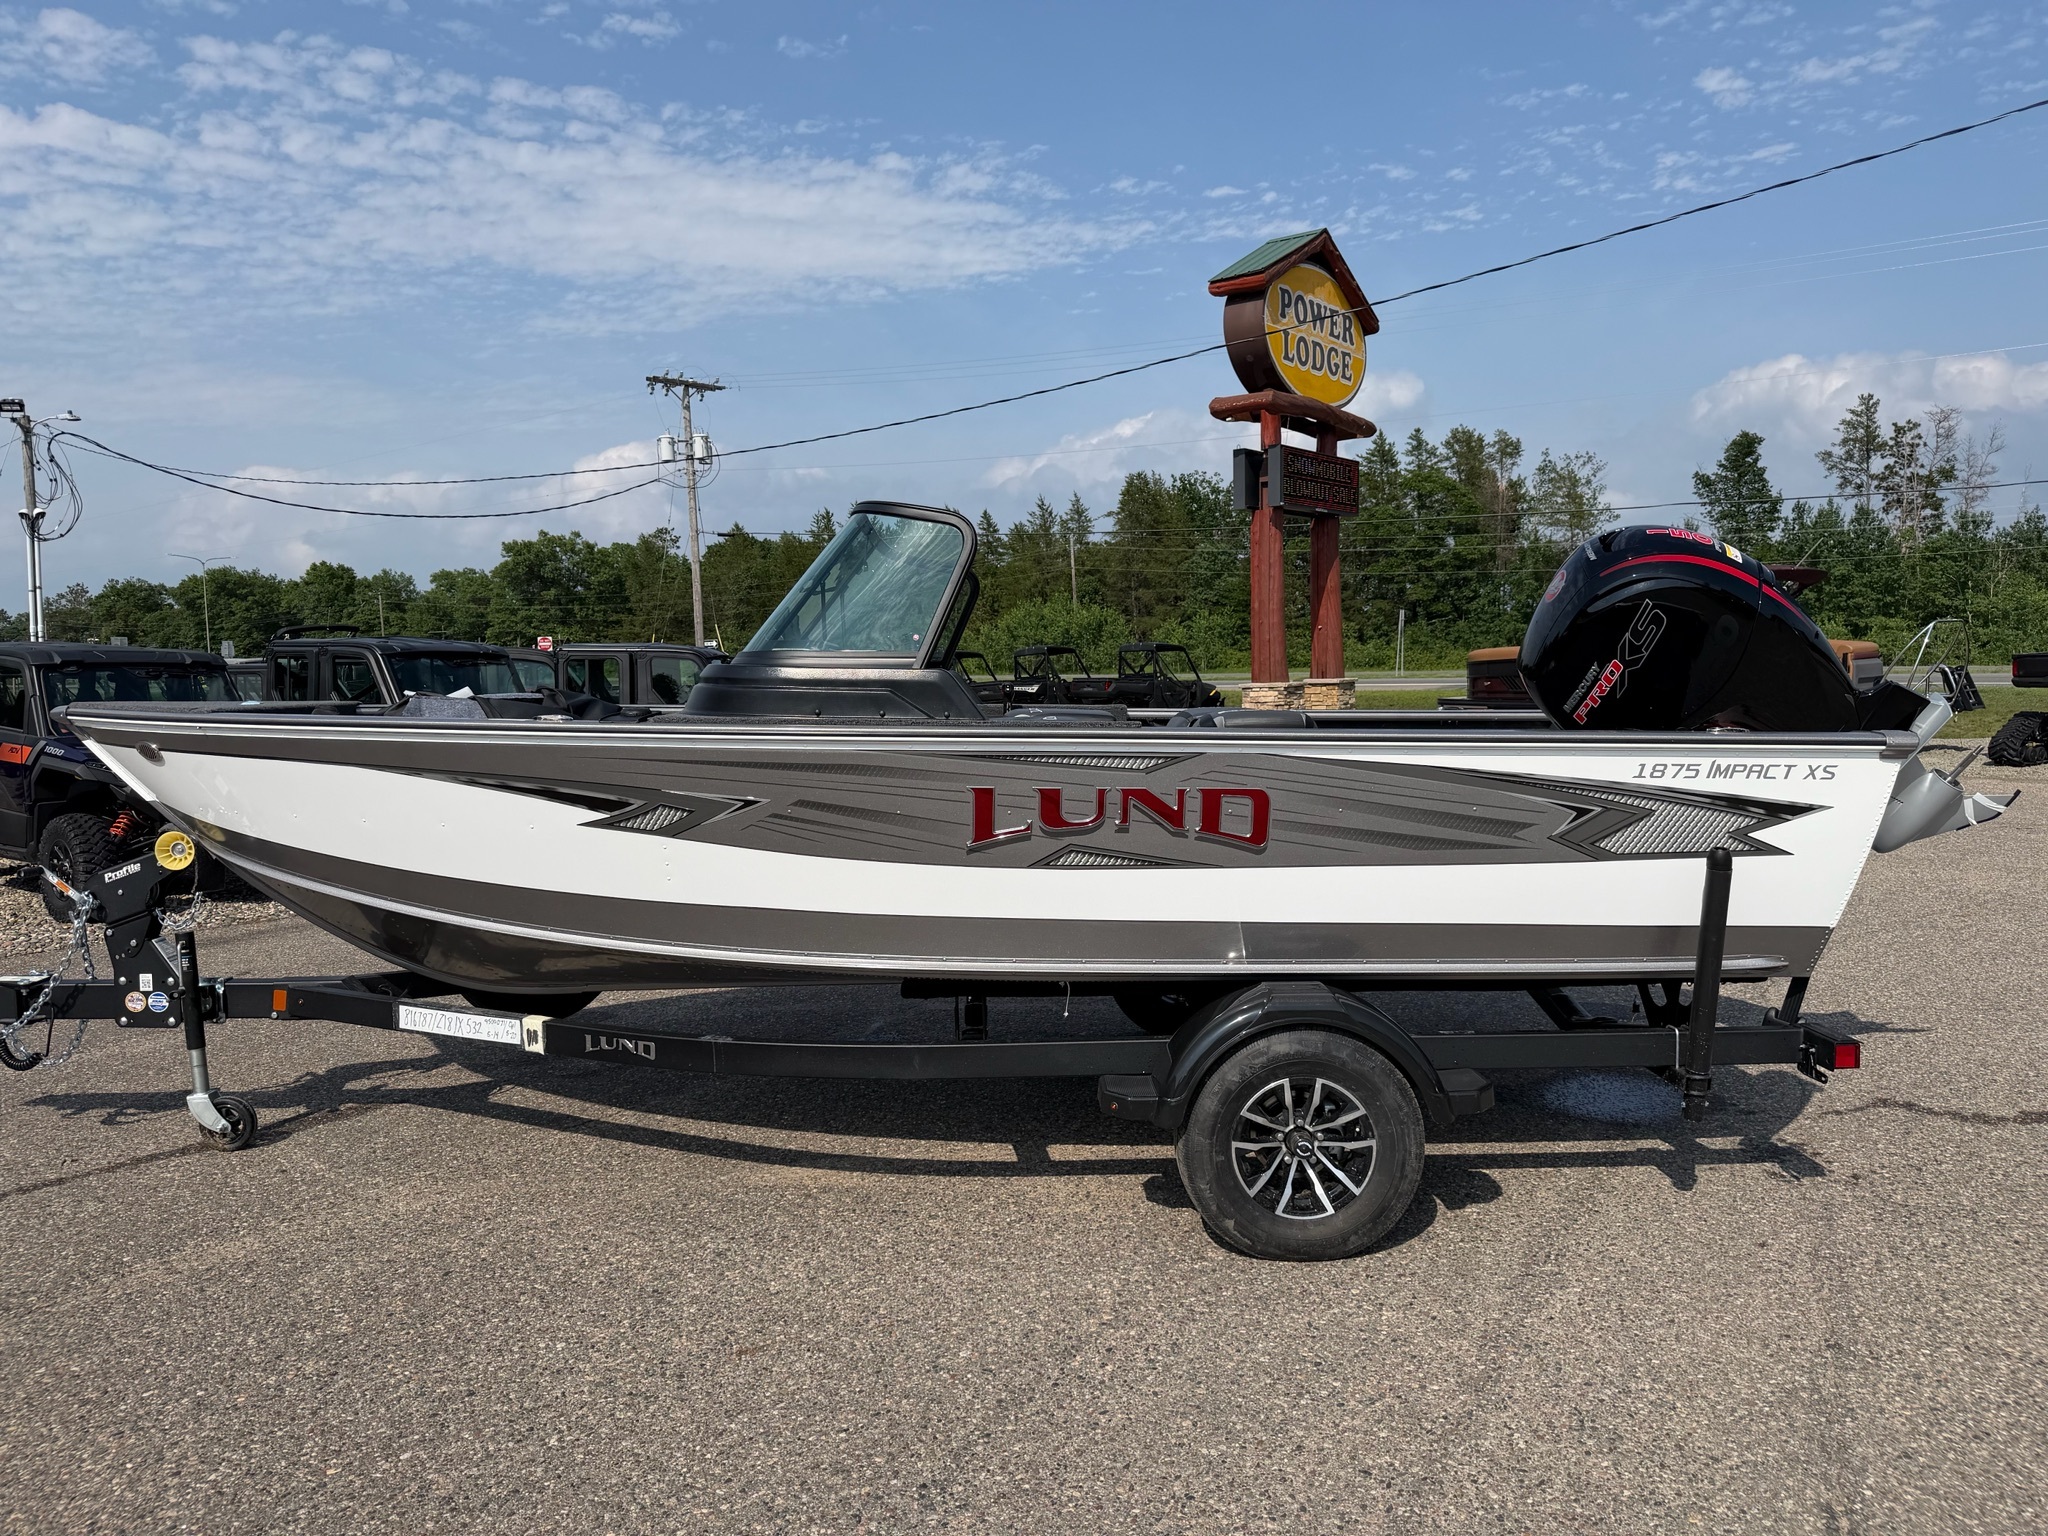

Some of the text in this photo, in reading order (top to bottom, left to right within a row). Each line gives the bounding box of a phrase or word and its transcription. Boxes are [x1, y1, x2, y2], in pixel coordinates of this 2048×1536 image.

[1279, 286, 1354, 346] POWER
[1282, 330, 1352, 382] LODGE
[1646, 528, 1714, 545] 150
[1573, 598, 1667, 725] PRO XS
[1562, 661, 1601, 713] MERCURY
[44, 745, 65, 756] 1000
[1632, 759, 1839, 780] 1875 IMPACT XS
[966, 786, 1271, 848] LUND
[104, 863, 141, 883] Profile
[584, 1034, 656, 1061] LUND
